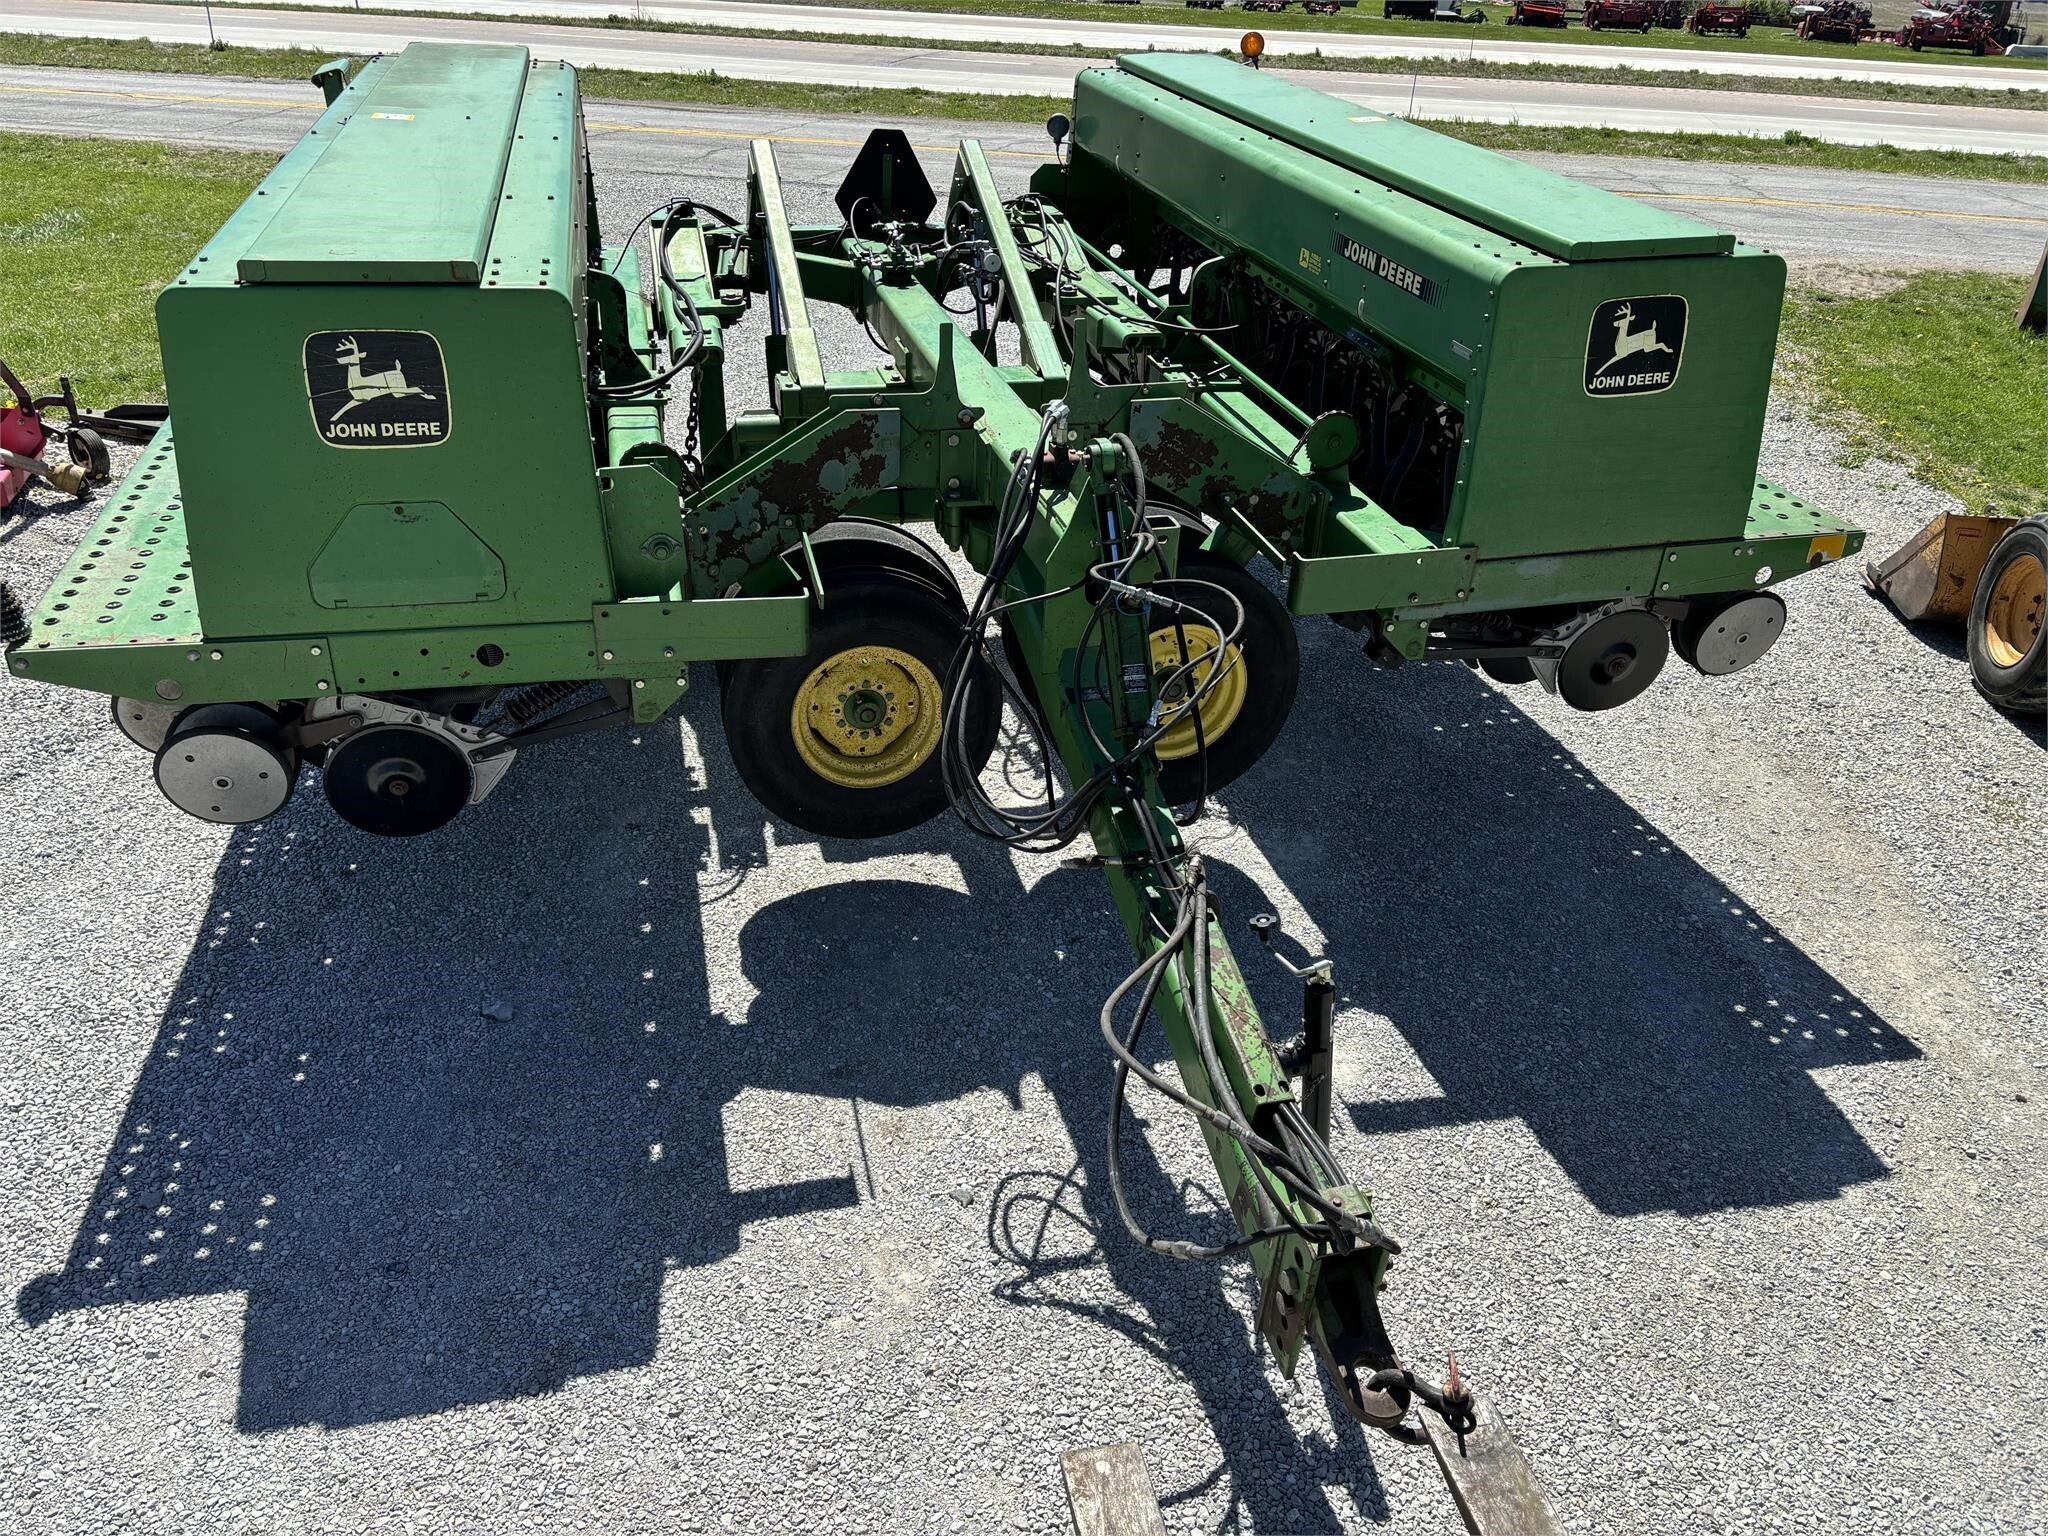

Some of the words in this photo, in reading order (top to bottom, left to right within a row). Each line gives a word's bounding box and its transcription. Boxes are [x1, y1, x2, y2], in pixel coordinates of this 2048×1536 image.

[1344, 240, 1377, 271] JOHN
[1378, 256, 1423, 296] DEERE
[1588, 375, 1625, 389] JOHN
[1627, 371, 1670, 386] DEERE
[326, 423, 377, 438] JOHN
[380, 422, 442, 437] DEERE
